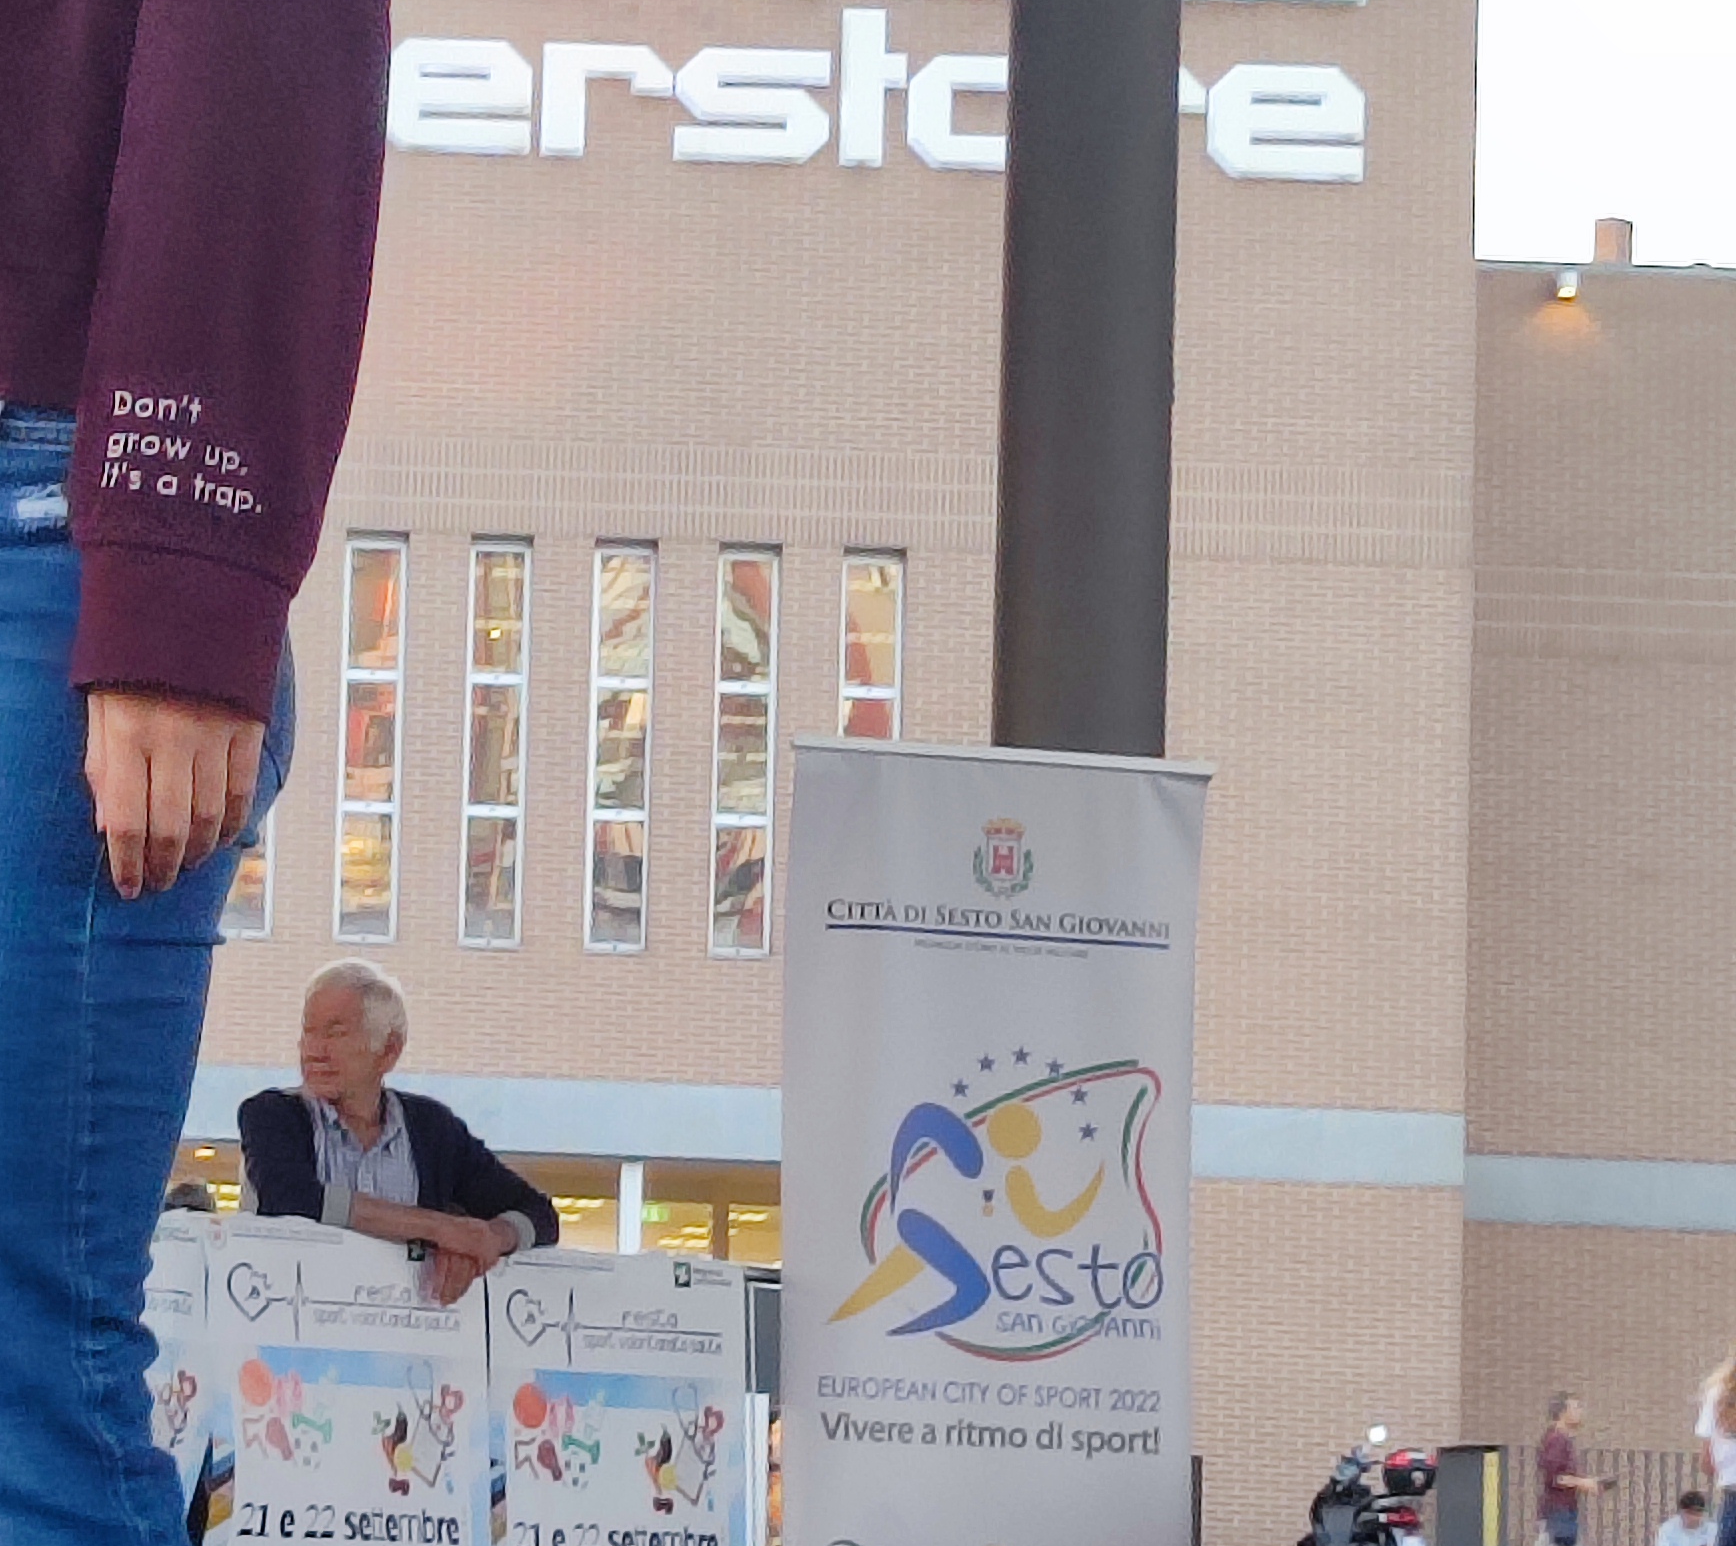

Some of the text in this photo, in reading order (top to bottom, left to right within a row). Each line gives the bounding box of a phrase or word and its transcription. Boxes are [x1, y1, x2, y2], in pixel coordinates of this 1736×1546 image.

[112, 389, 202, 425] Don't
[106, 432, 192, 460] grow
[156, 474, 178, 496] a
[193, 472, 263, 514] trap.
[935, 906, 1003, 928] SESTO
[1010, 908, 1051, 931] SAN
[1058, 913, 1170, 939] GIOVANNI
[817, 1375, 1161, 1413] EUROPEAN CITY OF SPORT 2022
[820, 1411, 1161, 1460] Vivere a ritmo di sport!
[236, 1502, 460, 1545] 21 e 22 settembre
